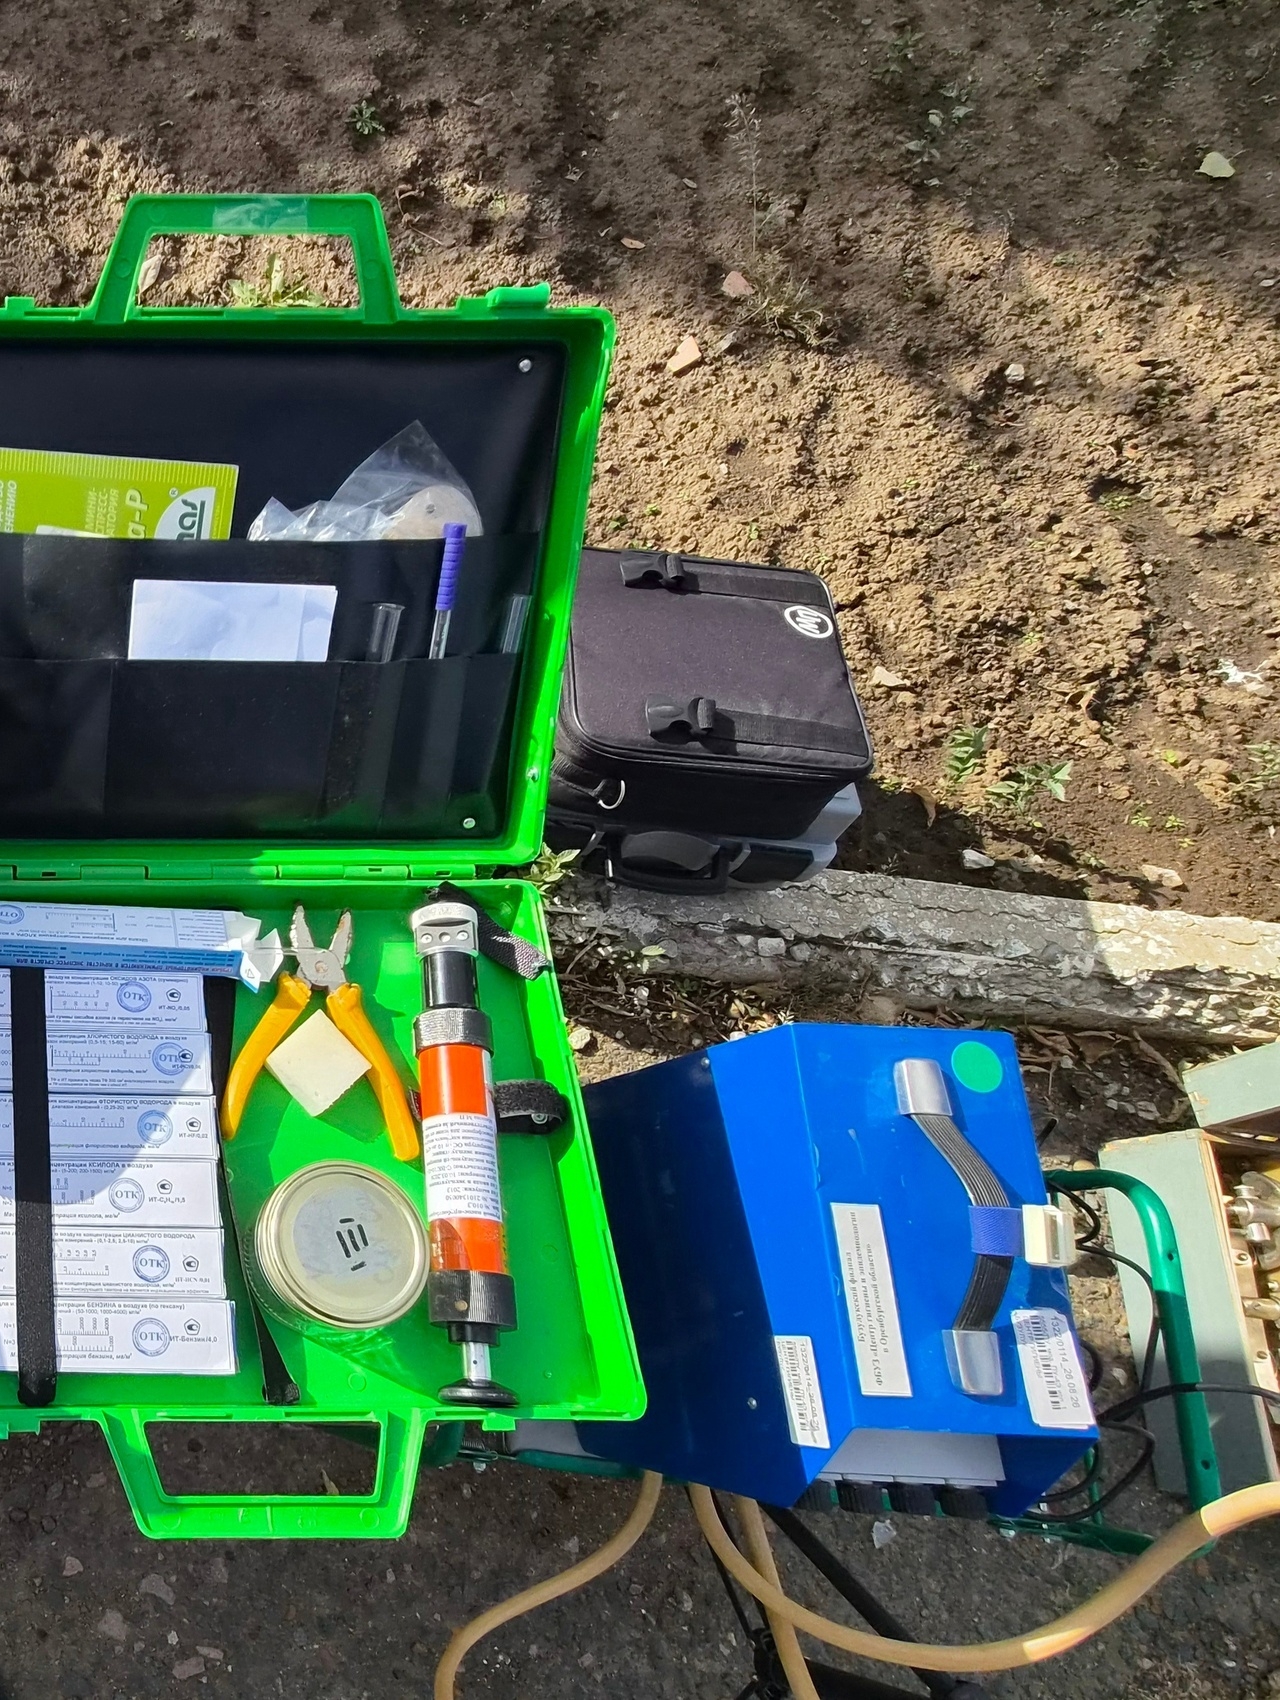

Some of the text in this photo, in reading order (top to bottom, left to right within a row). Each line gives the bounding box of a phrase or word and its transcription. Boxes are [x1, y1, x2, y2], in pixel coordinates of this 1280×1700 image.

[124, 991, 146, 1001] ОТК
[144, 1123, 167, 1132] ОТК
[115, 1190, 139, 1199] ОТК
[849, 1211, 865, 1275] эпидемиологии
[140, 1258, 164, 1268] ОТК
[866, 1243, 877, 1282] области»
[845, 1252, 866, 1342] Бузулукский филиал
[861, 1286, 873, 1322] гигиены
[872, 1284, 888, 1345] Оренбургской
[139, 1332, 164, 1341] ОТК
[867, 1324, 879, 1356] «Центр
[872, 1359, 883, 1386] ФБУЗ
